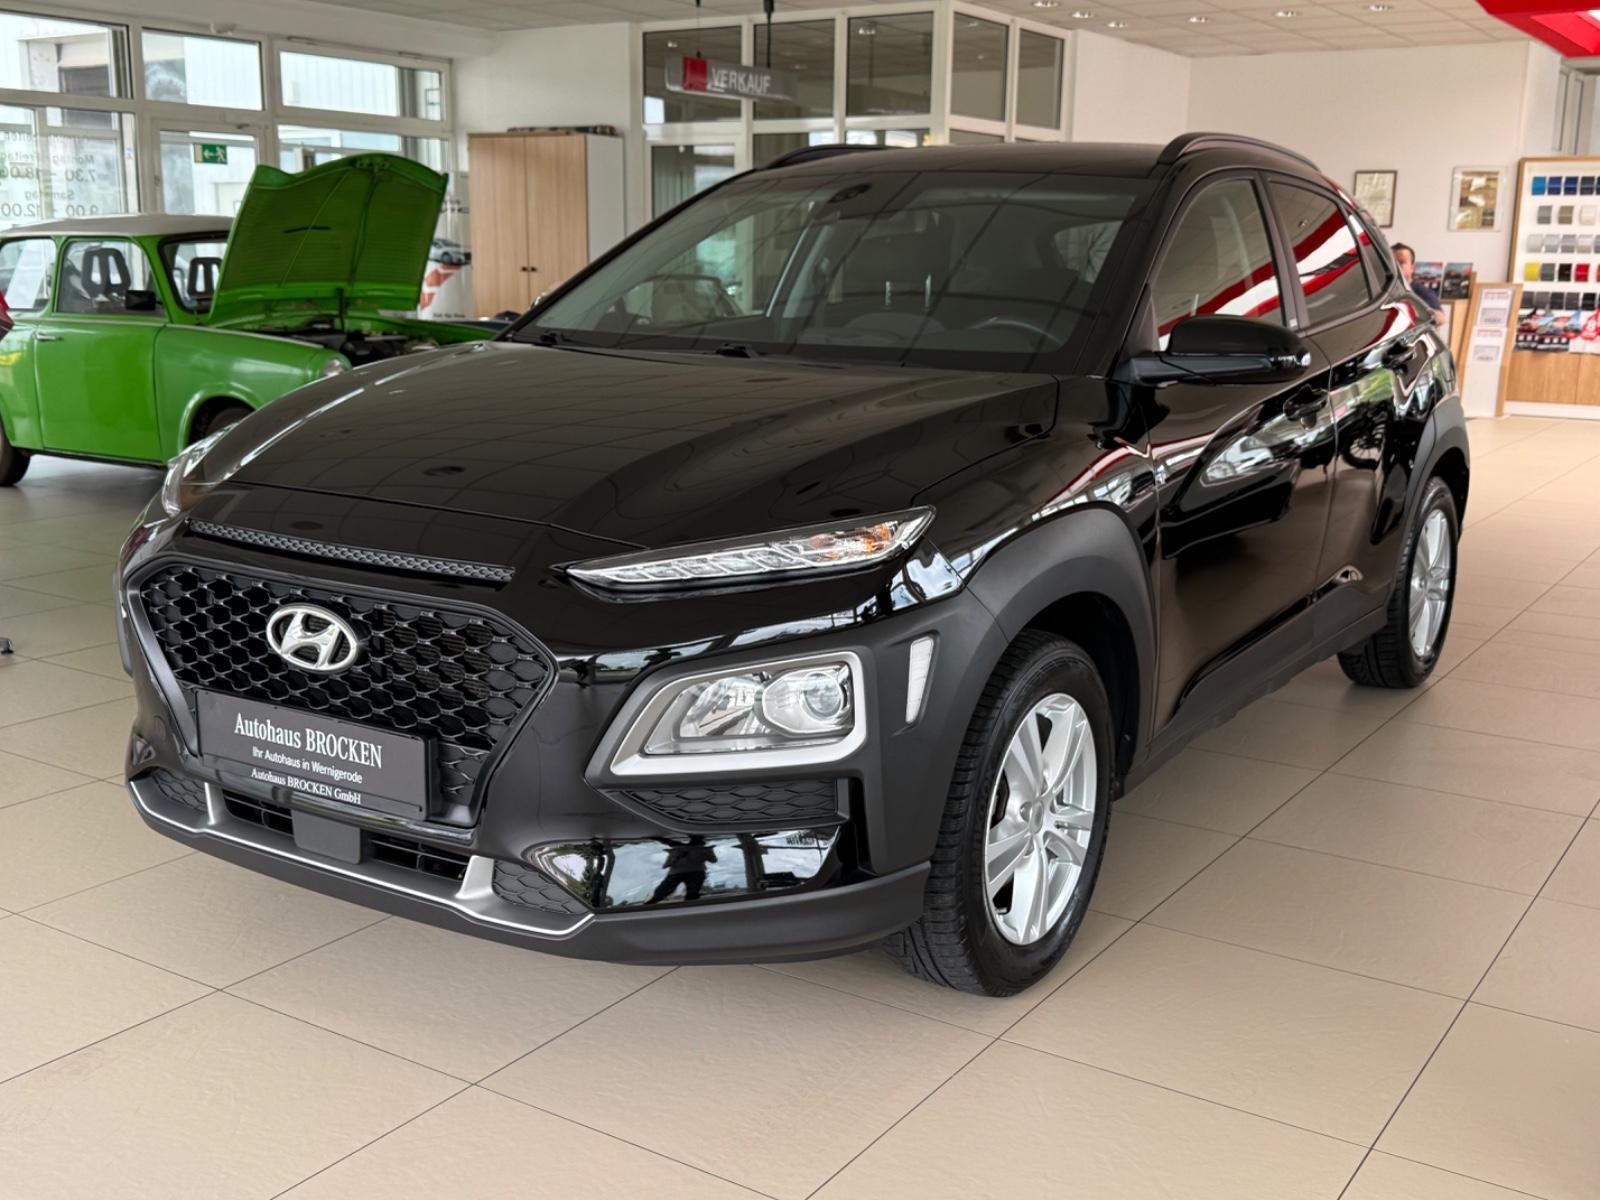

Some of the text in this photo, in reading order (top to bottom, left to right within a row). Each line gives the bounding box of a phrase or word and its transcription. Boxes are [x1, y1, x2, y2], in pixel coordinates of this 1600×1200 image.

[711, 68, 771, 93] VERKAUF
[234, 713, 383, 769] Autohaus BROCKEN
[252, 746, 363, 784] Ihr Autohaus in Wernigerode
[251, 768, 362, 805] Autohaus BROCKEN GmbH
